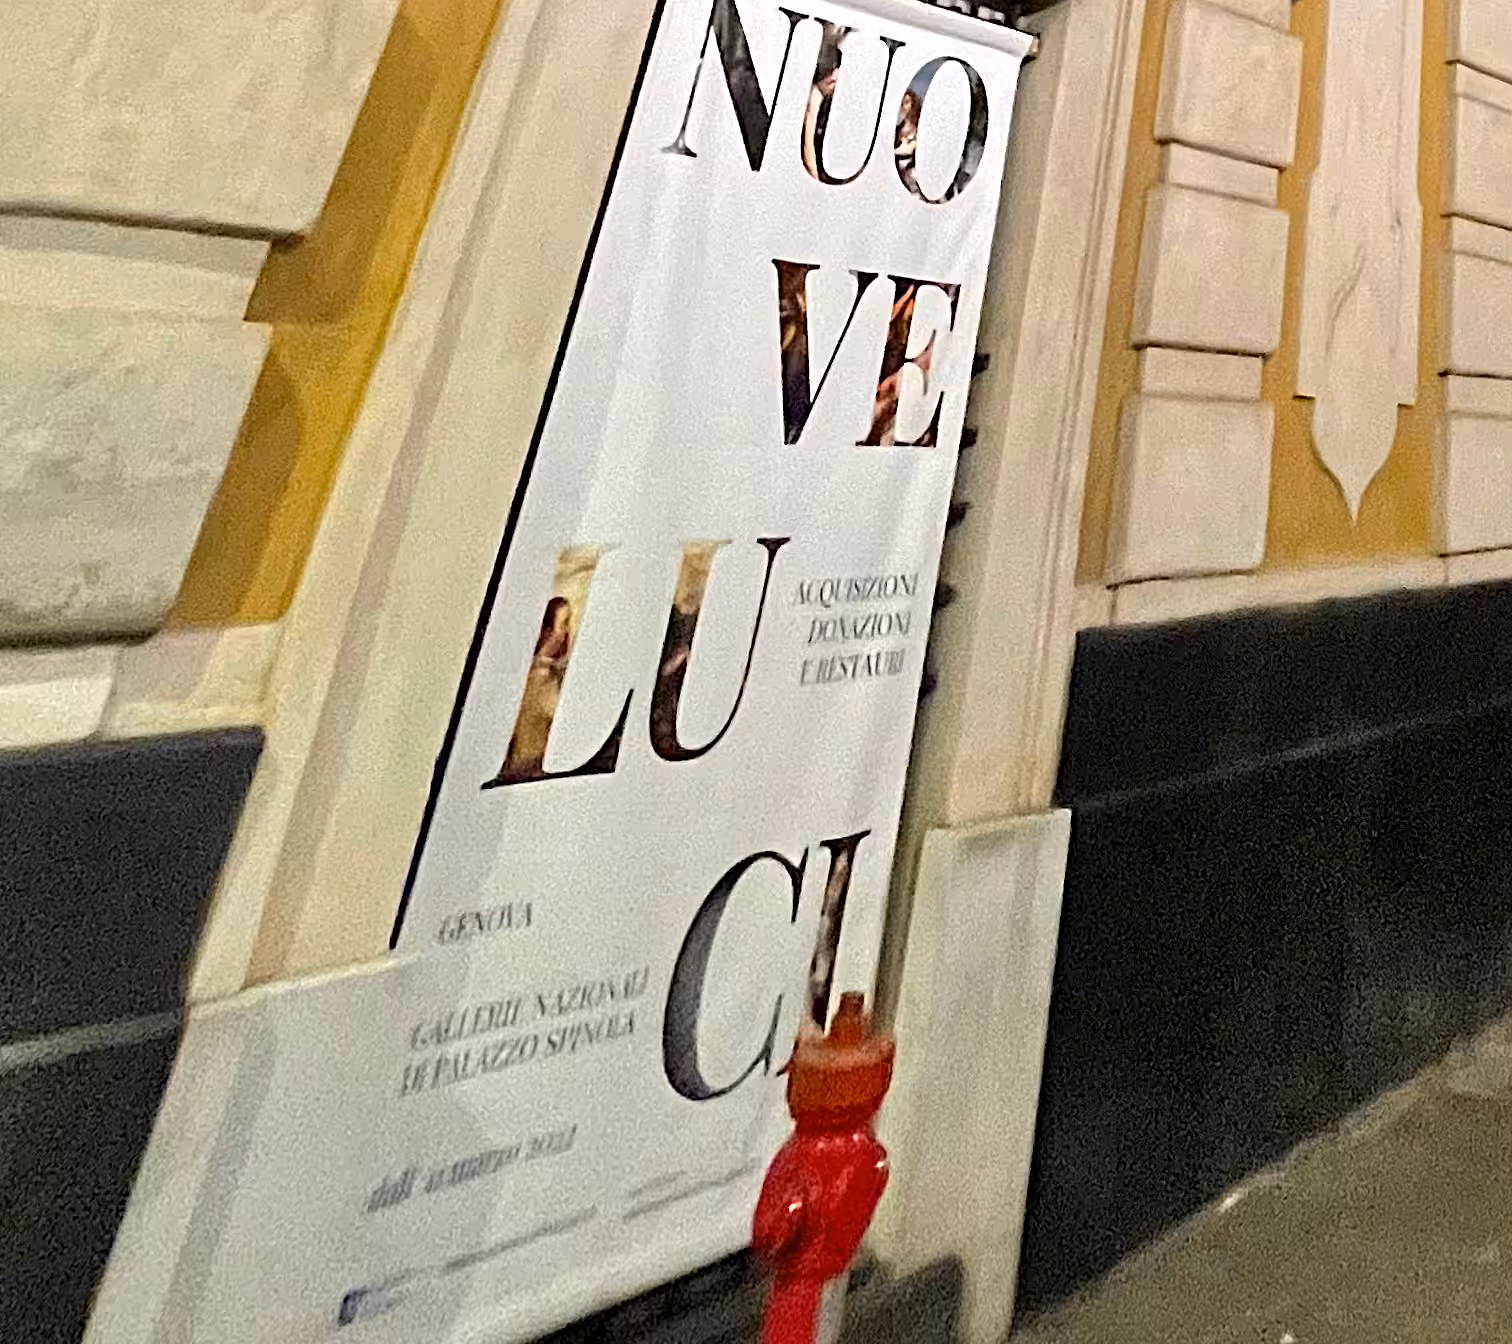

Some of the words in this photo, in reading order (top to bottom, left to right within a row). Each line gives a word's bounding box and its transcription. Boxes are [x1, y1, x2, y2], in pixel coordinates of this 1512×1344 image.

[771, 258, 962, 448] VE
[480, 537, 791, 791] LU
[807, 611, 912, 645] DONAZIONI
[437, 900, 533, 946] GENOVA
[661, 828, 872, 1101] CI
